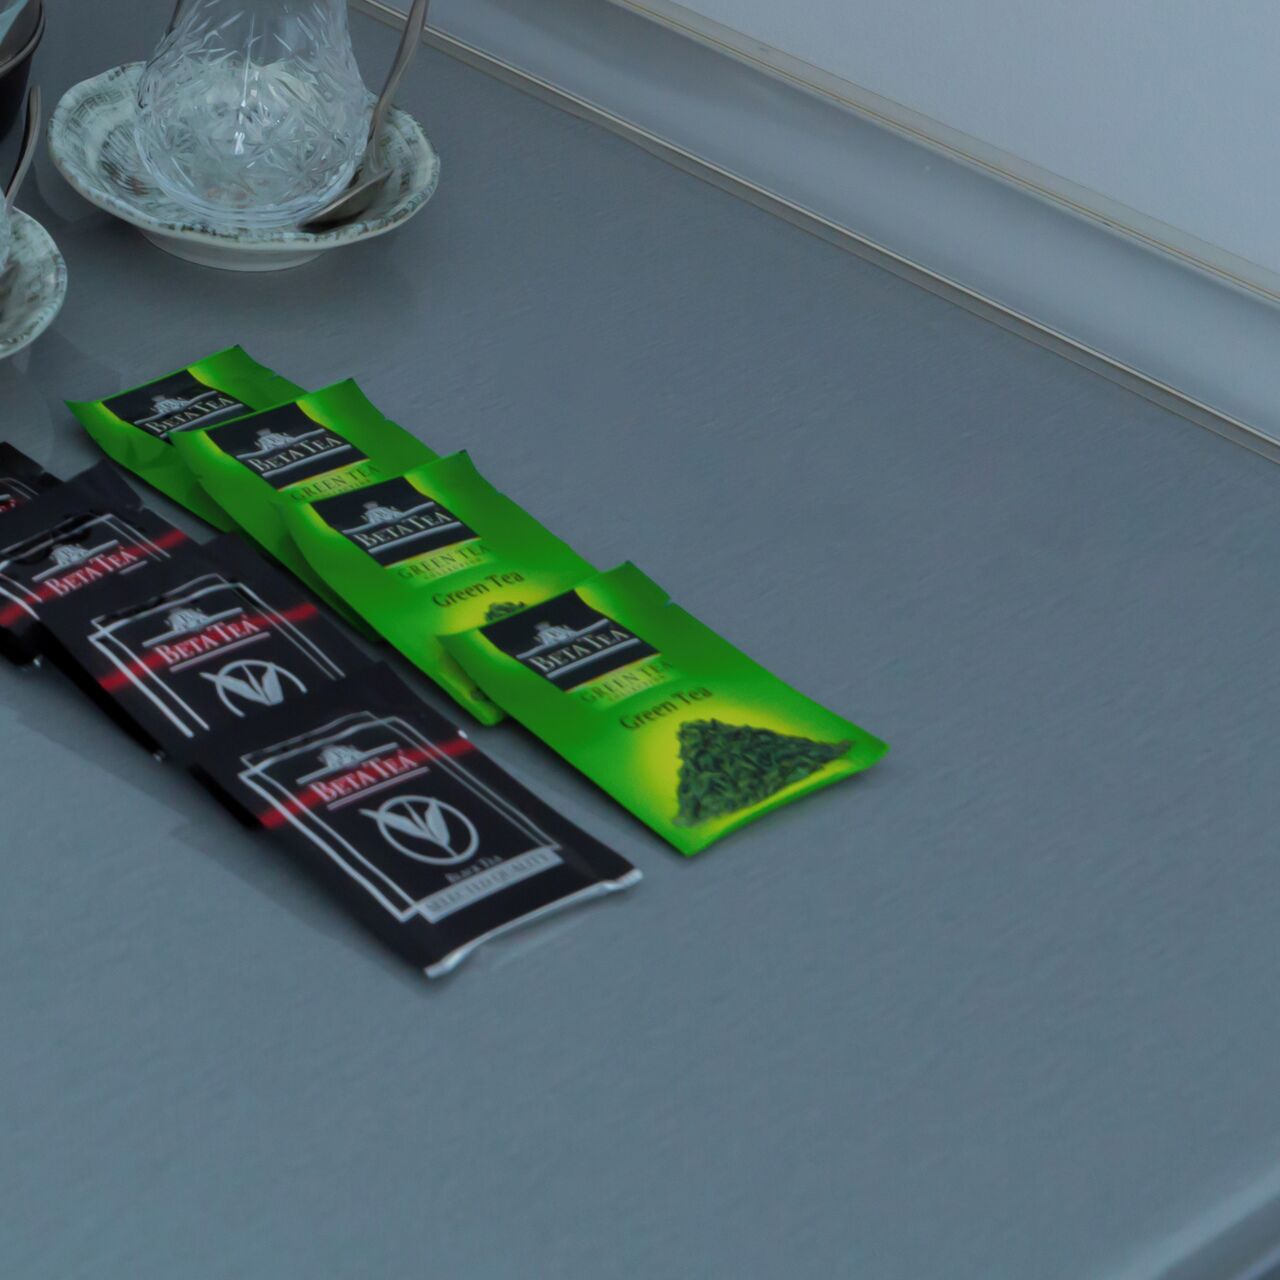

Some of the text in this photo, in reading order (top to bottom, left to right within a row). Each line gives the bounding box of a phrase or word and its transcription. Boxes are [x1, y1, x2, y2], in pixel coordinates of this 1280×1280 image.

[432, 571, 525, 608] Green Tea
[619, 700, 679, 730] Green
[671, 686, 713, 705] Tea
